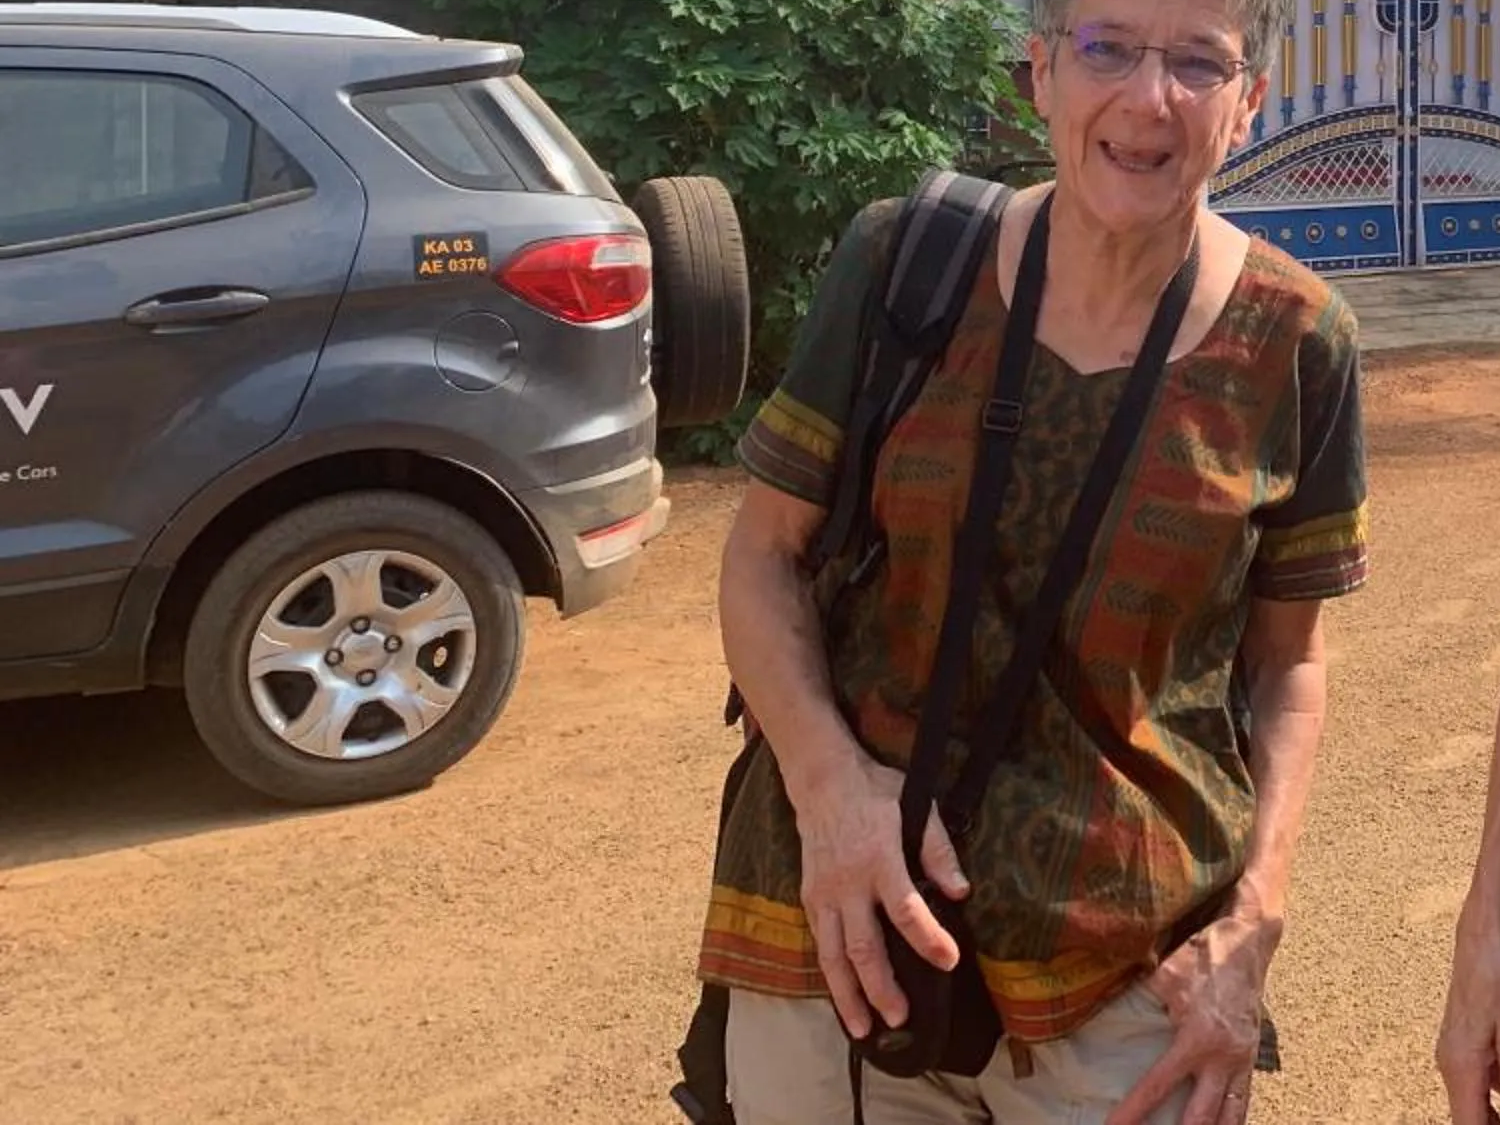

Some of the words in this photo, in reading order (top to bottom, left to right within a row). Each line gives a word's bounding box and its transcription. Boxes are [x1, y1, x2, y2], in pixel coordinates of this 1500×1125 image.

[424, 240, 449, 254] KA
[453, 239, 474, 252] 03
[419, 260, 444, 275] AE
[448, 257, 487, 272] 0376
[17, 465, 57, 480] Cars
